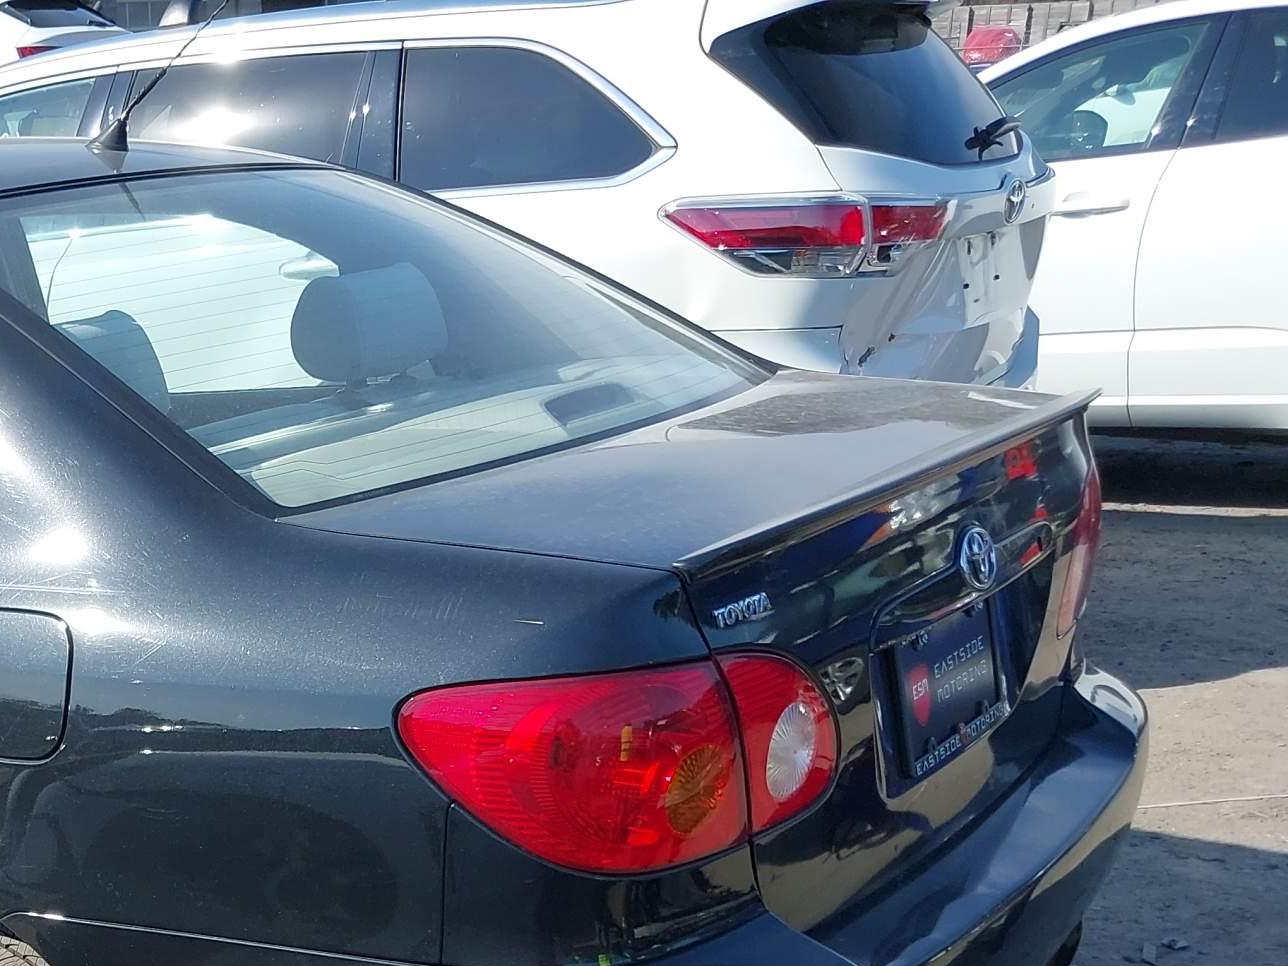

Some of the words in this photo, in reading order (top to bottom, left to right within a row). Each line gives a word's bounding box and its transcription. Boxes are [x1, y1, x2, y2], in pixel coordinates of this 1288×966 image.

[712, 592, 772, 629] TOYOTA
[933, 635, 985, 679] EASTSIDE
[912, 678, 929, 701] ESM
[937, 659, 987, 704] MOTORING
[915, 735, 962, 776] EASTSIDE
